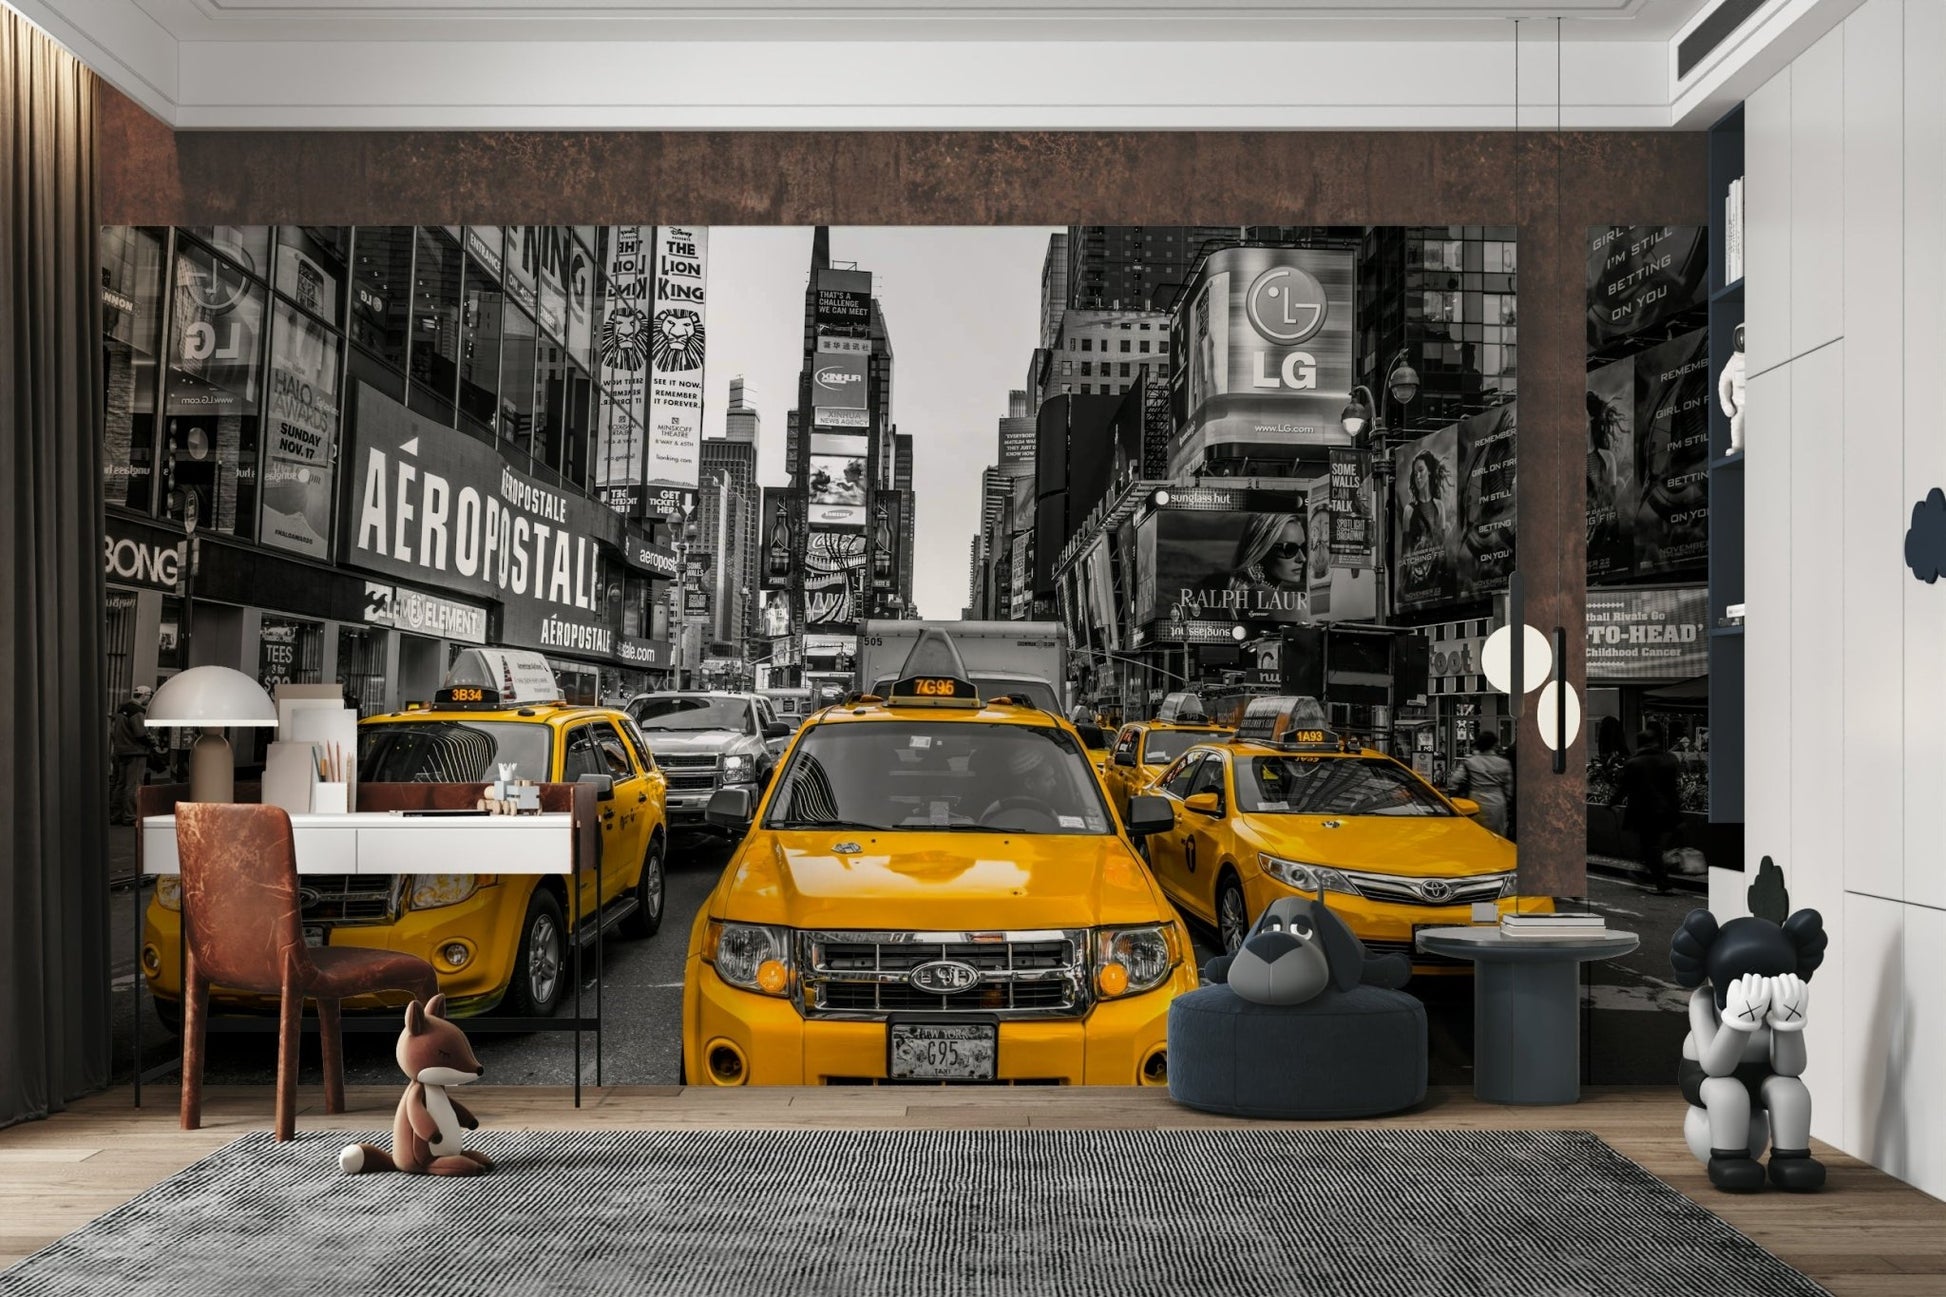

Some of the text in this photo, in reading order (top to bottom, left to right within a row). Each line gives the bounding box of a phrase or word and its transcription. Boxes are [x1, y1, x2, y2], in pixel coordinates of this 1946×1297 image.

[1593, 228, 1624, 251] GIRL
[666, 240, 696, 256] THE
[1607, 228, 1673, 270] I'M STILL
[661, 255, 701, 276] LION
[1608, 255, 1672, 296] BETTING
[658, 277, 704, 301] KING
[820, 291, 851, 300] THAT'S A
[819, 298, 859, 308] CHALLENGE
[1612, 285, 1668, 321] ON YOU
[819, 305, 830, 313] WE
[849, 307, 868, 316] MEET
[1253, 351, 1317, 389] LG
[653, 378, 702, 389] SEE IT NOW.
[655, 389, 698, 400] REMEMBER
[653, 397, 701, 409] IT FOREVER.
[1656, 404, 1681, 420] GIRL
[1684, 398, 1701, 411] ON
[280, 422, 322, 448] SUNDAY
[1254, 424, 1314, 434] www.LG.com
[1474, 428, 1517, 449] REMEMBER
[279, 438, 315, 460] NOV. 17
[1667, 442, 1682, 452] I'M
[1331, 463, 1357, 476] SOME
[1331, 475, 1360, 488] WALLS
[501, 464, 568, 524] AÉROPOSTALE
[660, 490, 681, 499] GET
[1170, 493, 1231, 505] sunglass hut
[1331, 487, 1350, 500] CAN
[1490, 489, 1512, 502] STILL
[1331, 500, 1353, 512] TALK
[1670, 511, 1688, 524] ON
[1478, 519, 1512, 534] BETTING
[1480, 550, 1510, 562] ON YOU
[1180, 588, 1250, 608] RALPH
[425, 600, 479, 635] ELEMENT
[1613, 612, 1648, 622] Rivals
[1651, 611, 1666, 621] Go
[541, 613, 612, 653] AÉROPOSTALE
[863, 636, 883, 647] 505
[266, 644, 294, 664] TEES
[1586, 647, 1682, 658] Childhood Cancer
[271, 664, 278, 675] 3
[451, 688, 483, 701] 3B34
[1297, 731, 1324, 742] 1A93
[928, 1040, 959, 1066] G95
